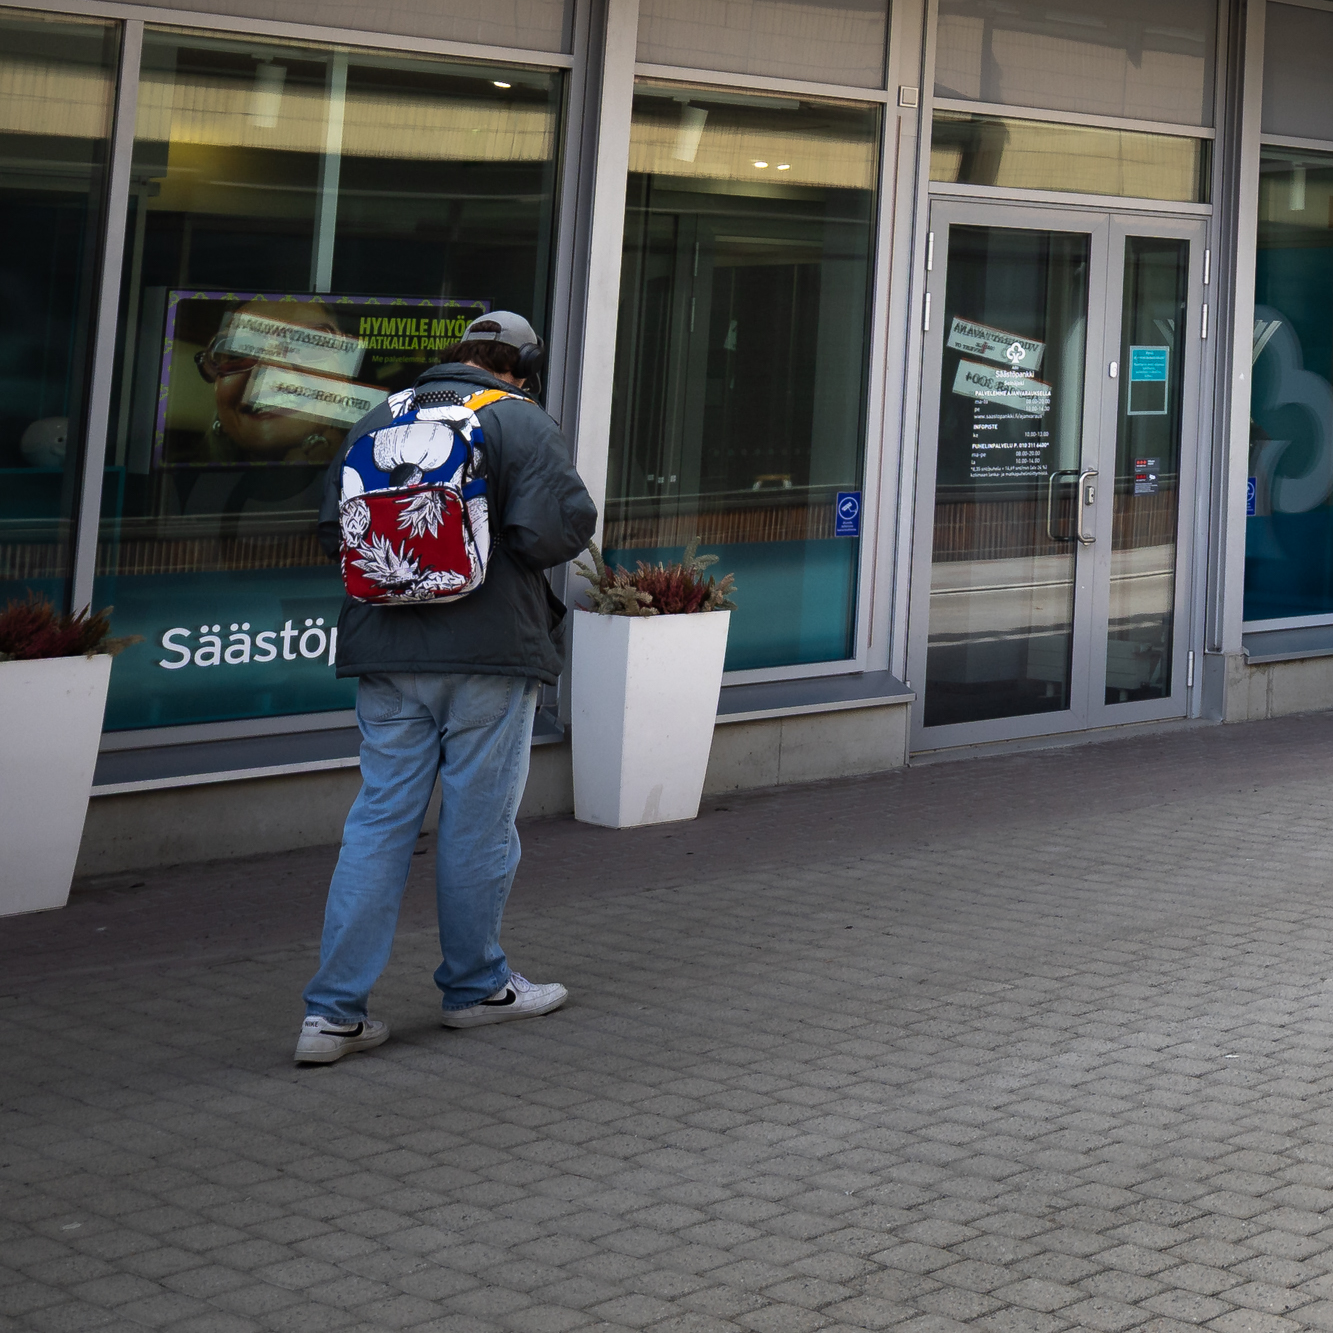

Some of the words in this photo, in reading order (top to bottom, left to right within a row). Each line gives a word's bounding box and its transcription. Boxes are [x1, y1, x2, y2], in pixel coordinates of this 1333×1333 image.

[359, 317, 429, 336] HYMYILE
[358, 336, 419, 350] MATKALLA
[995, 370, 1035, 379] Säästöpankki
